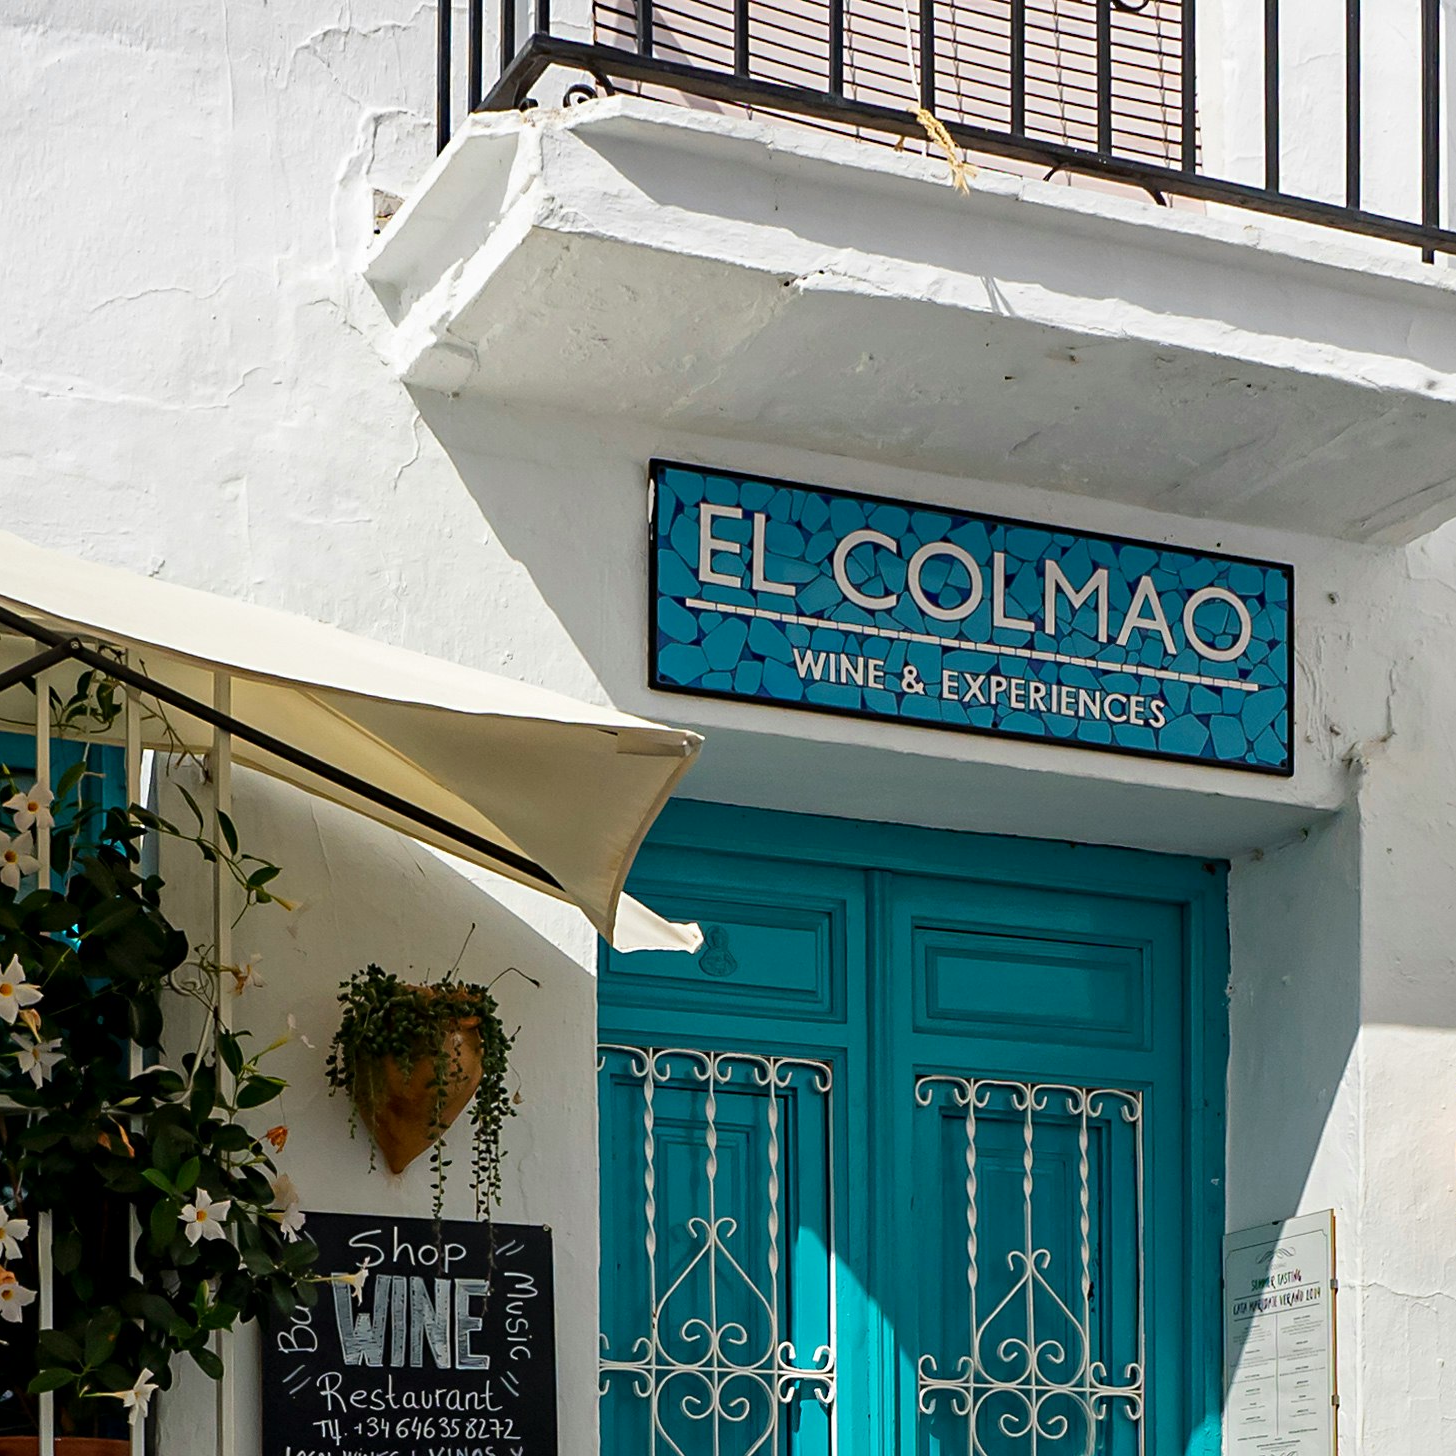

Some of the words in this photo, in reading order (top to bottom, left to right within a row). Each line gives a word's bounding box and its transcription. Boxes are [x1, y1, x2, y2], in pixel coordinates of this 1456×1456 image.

[698, 503, 796, 596] EL
[833, 530, 1251, 661] COLMAO
[793, 648, 885, 689] WINE
[902, 664, 925, 694] &
[942, 670, 1167, 728] EXPERIENCES
[348, 1226, 466, 1273] Shop
[331, 1272, 490, 1370] WINE
[504, 1272, 539, 1360] Music
[317, 1371, 503, 1413] Restaurant
